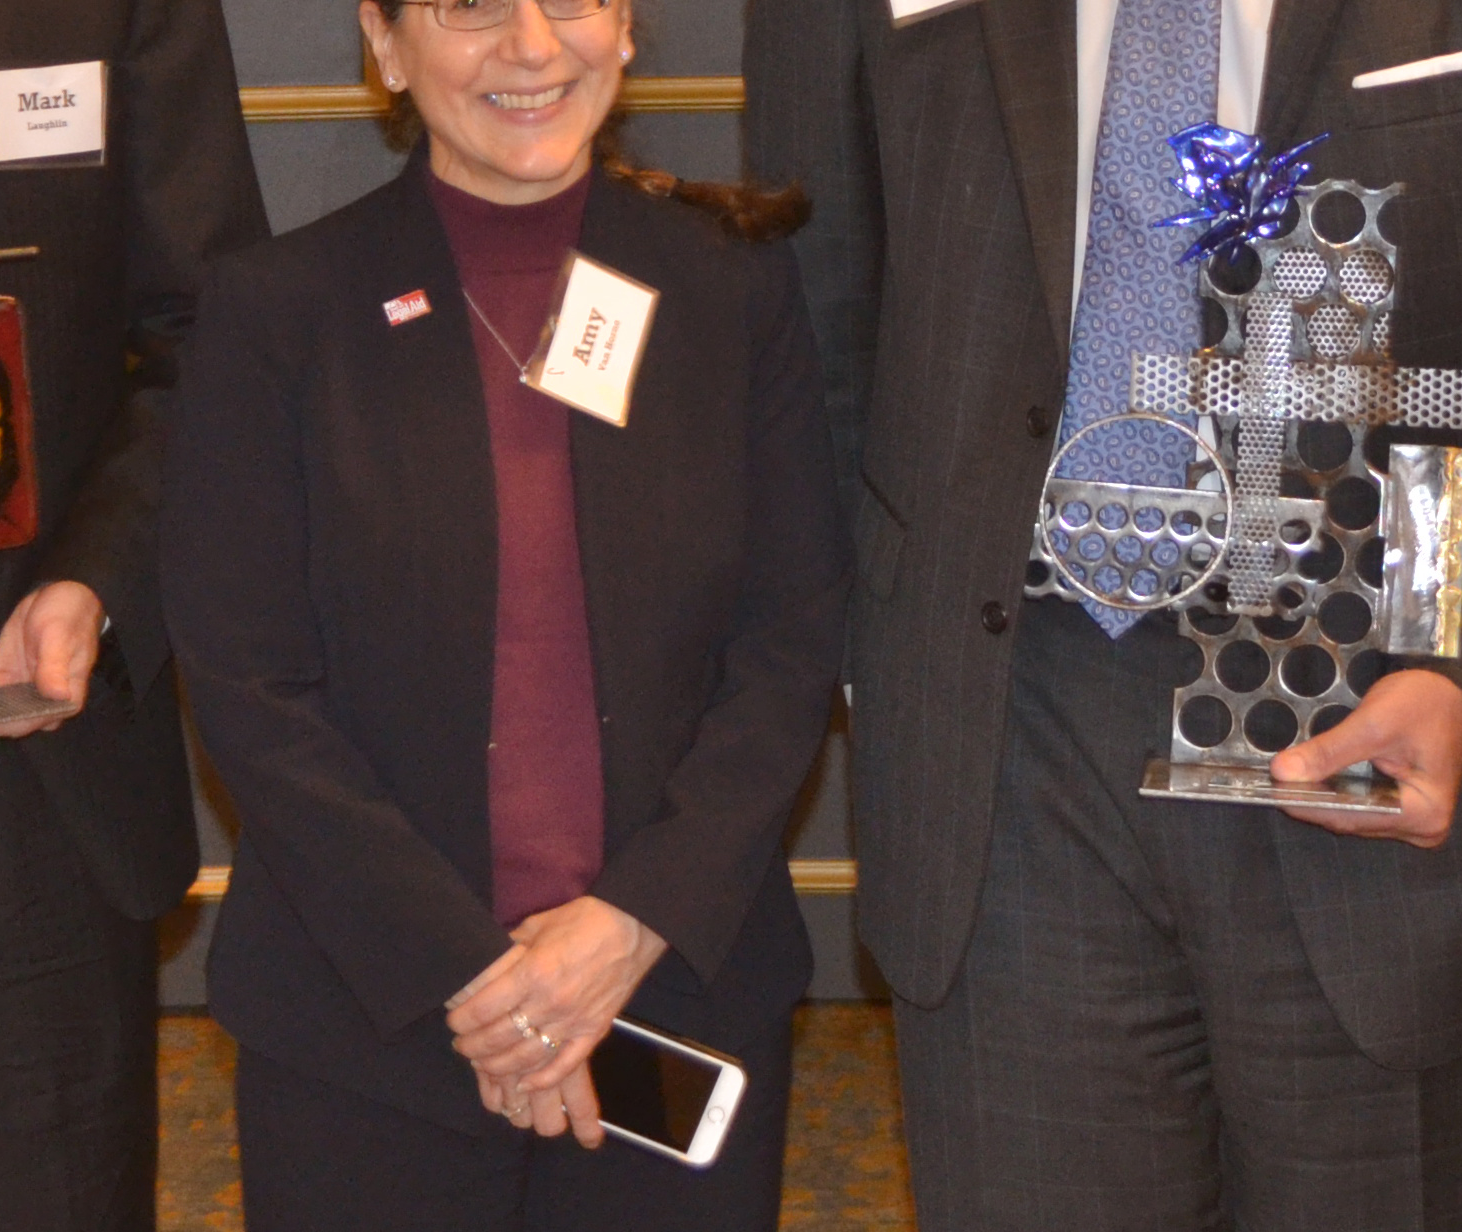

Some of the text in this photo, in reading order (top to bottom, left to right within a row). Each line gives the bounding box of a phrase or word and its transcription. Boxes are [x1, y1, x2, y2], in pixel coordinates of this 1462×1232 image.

[17, 89, 76, 112] Mark
[27, 119, 68, 131] Laughlin
[572, 307, 607, 367] Amy
[597, 352, 612, 371] Van
